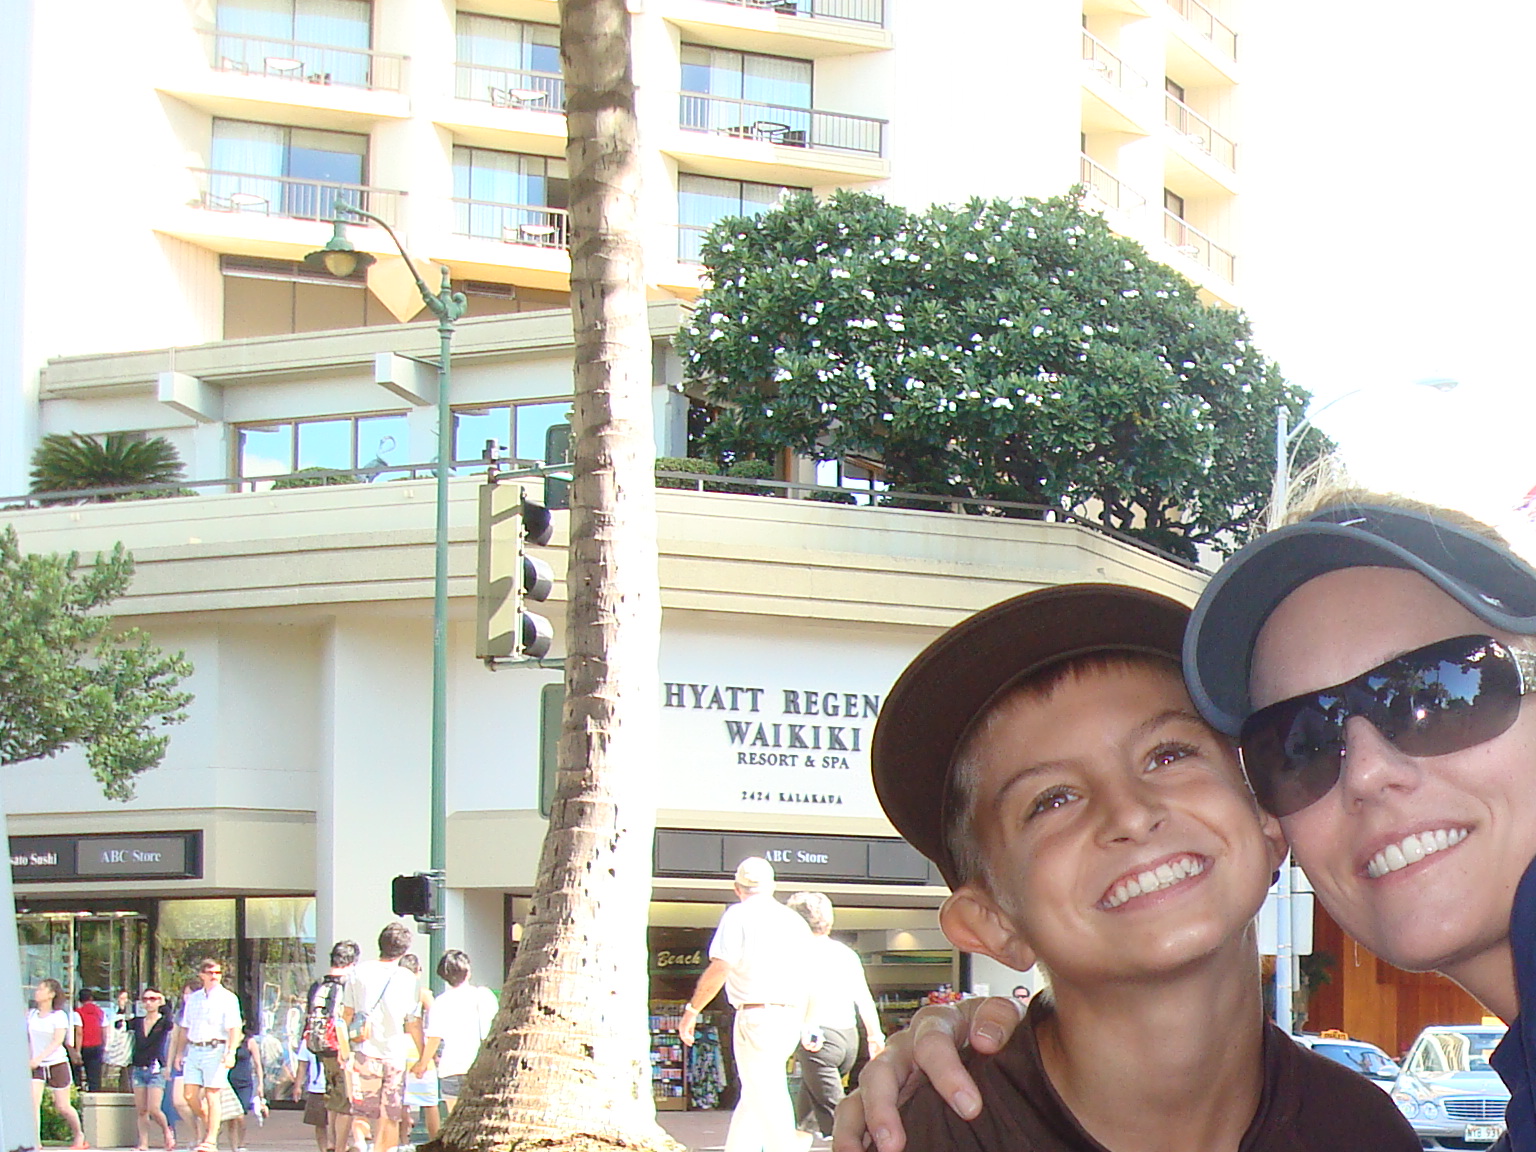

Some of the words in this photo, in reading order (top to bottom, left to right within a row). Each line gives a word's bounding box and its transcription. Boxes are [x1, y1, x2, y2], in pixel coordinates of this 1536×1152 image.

[664, 683, 764, 713] HYATT
[783, 690, 879, 718] REGEN
[725, 720, 861, 751] WAIKIKI
[738, 753, 798, 767] RESORT
[804, 757, 816, 768] &
[822, 758, 850, 769] SPA
[742, 791, 770, 801] 2424
[30, 852, 58, 865] Sushi
[101, 850, 128, 863] ABC
[132, 850, 161, 863] Store
[764, 850, 791, 863] ABC
[797, 851, 828, 864] Store
[657, 951, 700, 967] Beach
